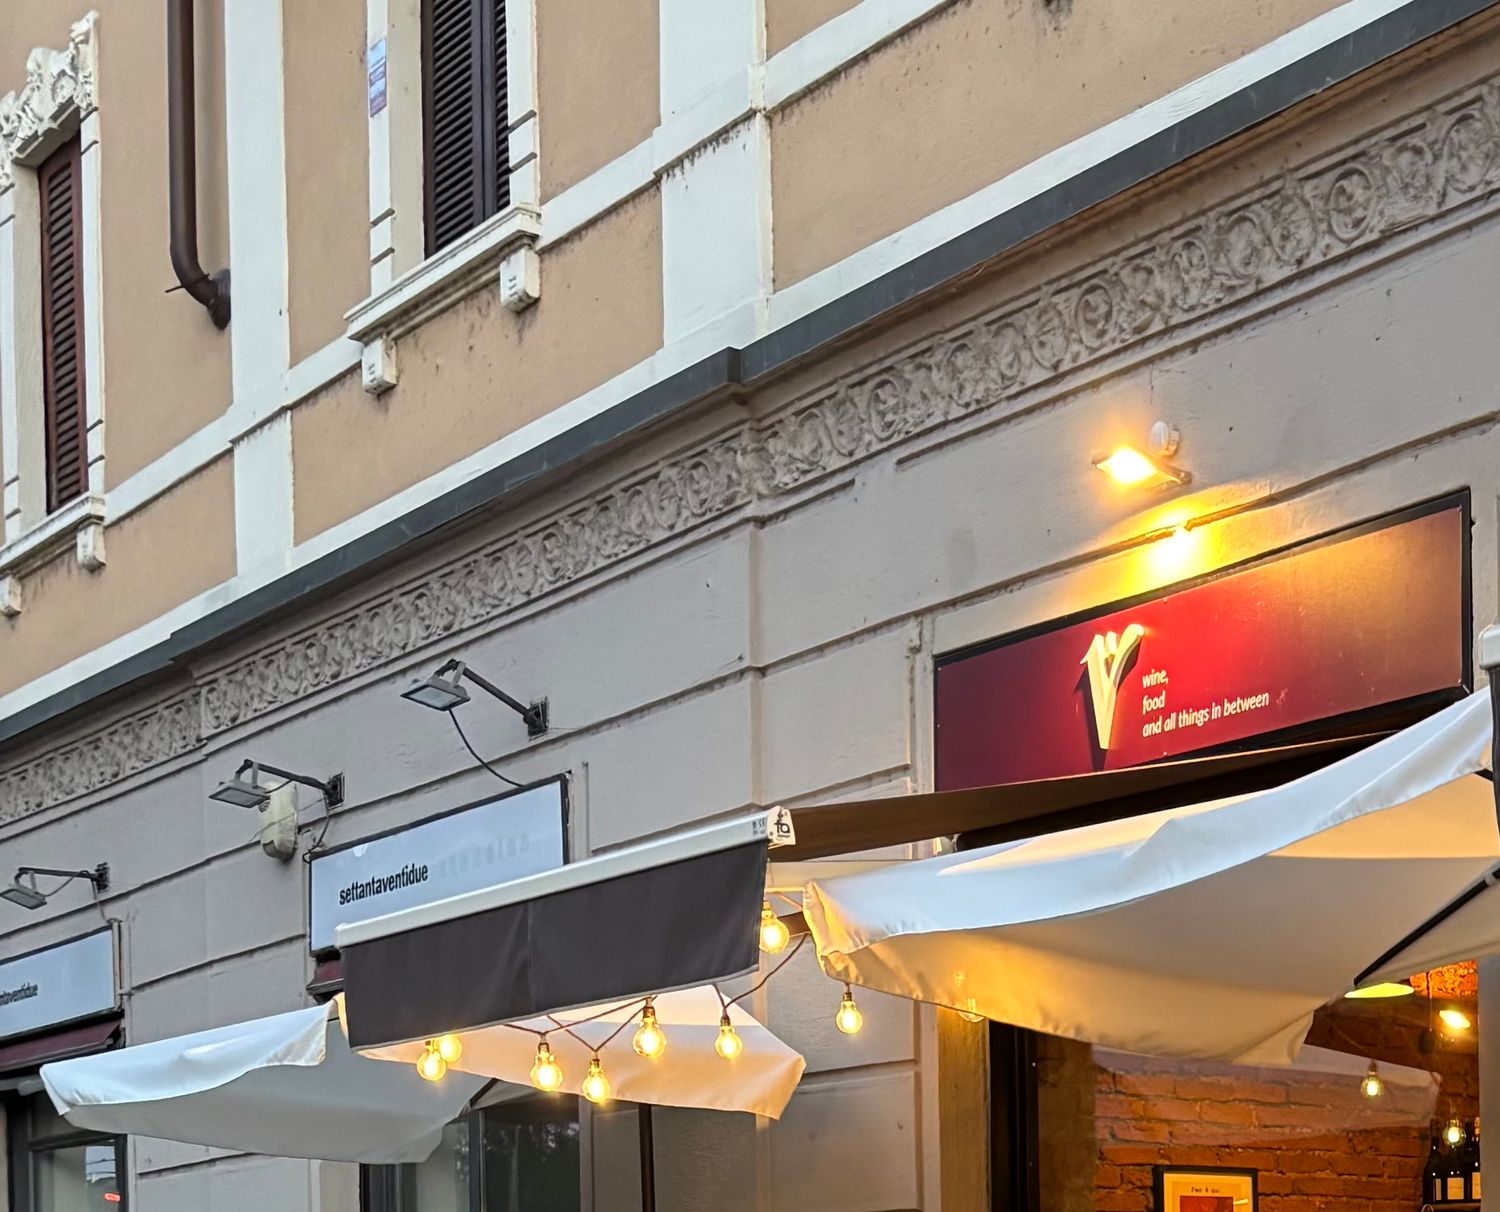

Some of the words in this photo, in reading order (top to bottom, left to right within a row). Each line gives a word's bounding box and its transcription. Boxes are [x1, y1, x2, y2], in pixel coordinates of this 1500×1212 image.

[1141, 668, 1169, 688] wine,
[1142, 690, 1166, 715] food
[1142, 715, 1162, 737] and
[1163, 710, 1176, 732] all
[1178, 706, 1210, 727] things
[1211, 702, 1222, 720] in
[1223, 692, 1270, 717] between
[339, 863, 429, 906] settantaventidue
